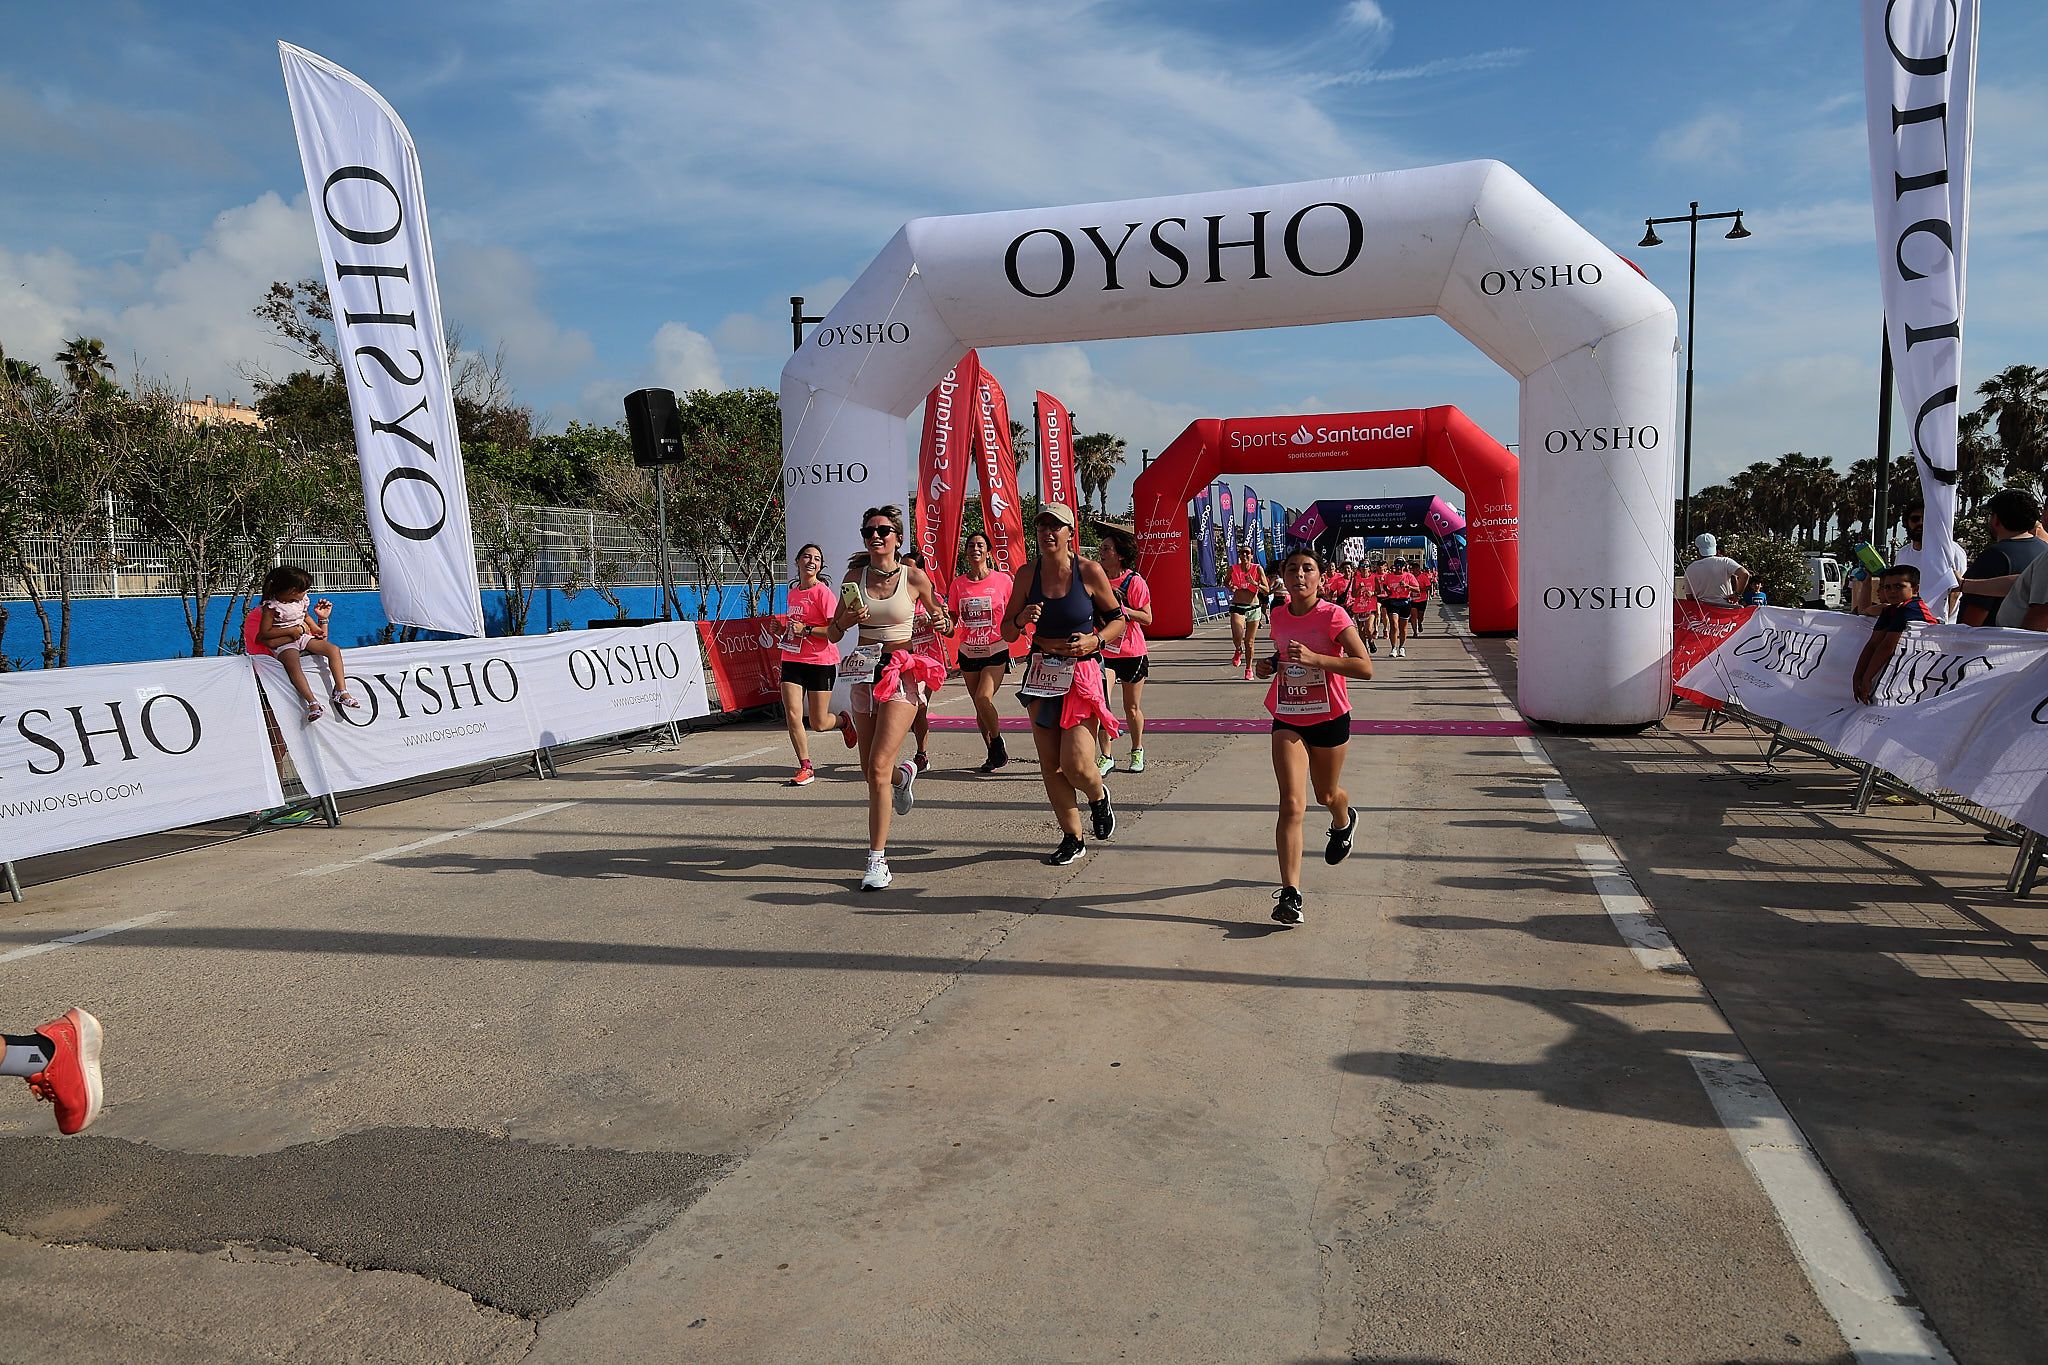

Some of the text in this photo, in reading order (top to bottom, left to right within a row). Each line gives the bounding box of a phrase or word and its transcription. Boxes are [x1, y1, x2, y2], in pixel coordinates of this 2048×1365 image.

[1004, 202, 1364, 298] OYSHO
[1480, 263, 1602, 296] OYSHO
[818, 322, 910, 347] OYSHO
[1230, 423, 1414, 452] Sports Santander
[1545, 425, 1659, 454] OYSHO
[1288, 450, 1349, 460] sportssantander.es
[786, 462, 868, 487] OYSHO
[1484, 503, 1513, 514] Sports
[1143, 530, 1182, 540] Santander
[1145, 517, 1171, 528] Sports
[1543, 585, 1656, 611] OYSHO
[717, 631, 759, 659] Sports
[1734, 628, 1828, 680] OYSHO
[568, 642, 680, 691] OYSHO
[848, 659, 865, 668] 016
[1870, 647, 1994, 705] YSHO
[1040, 673, 1058, 682] 016
[1287, 686, 1308, 695] 016
[333, 658, 519, 727] OYSHO
[611, 692, 662, 707] WWW.OYSHO.COM
[402, 721, 488, 747] WWW.OYSHO.COM
[0, 782, 144, 819] WW.OYSHO.COM
